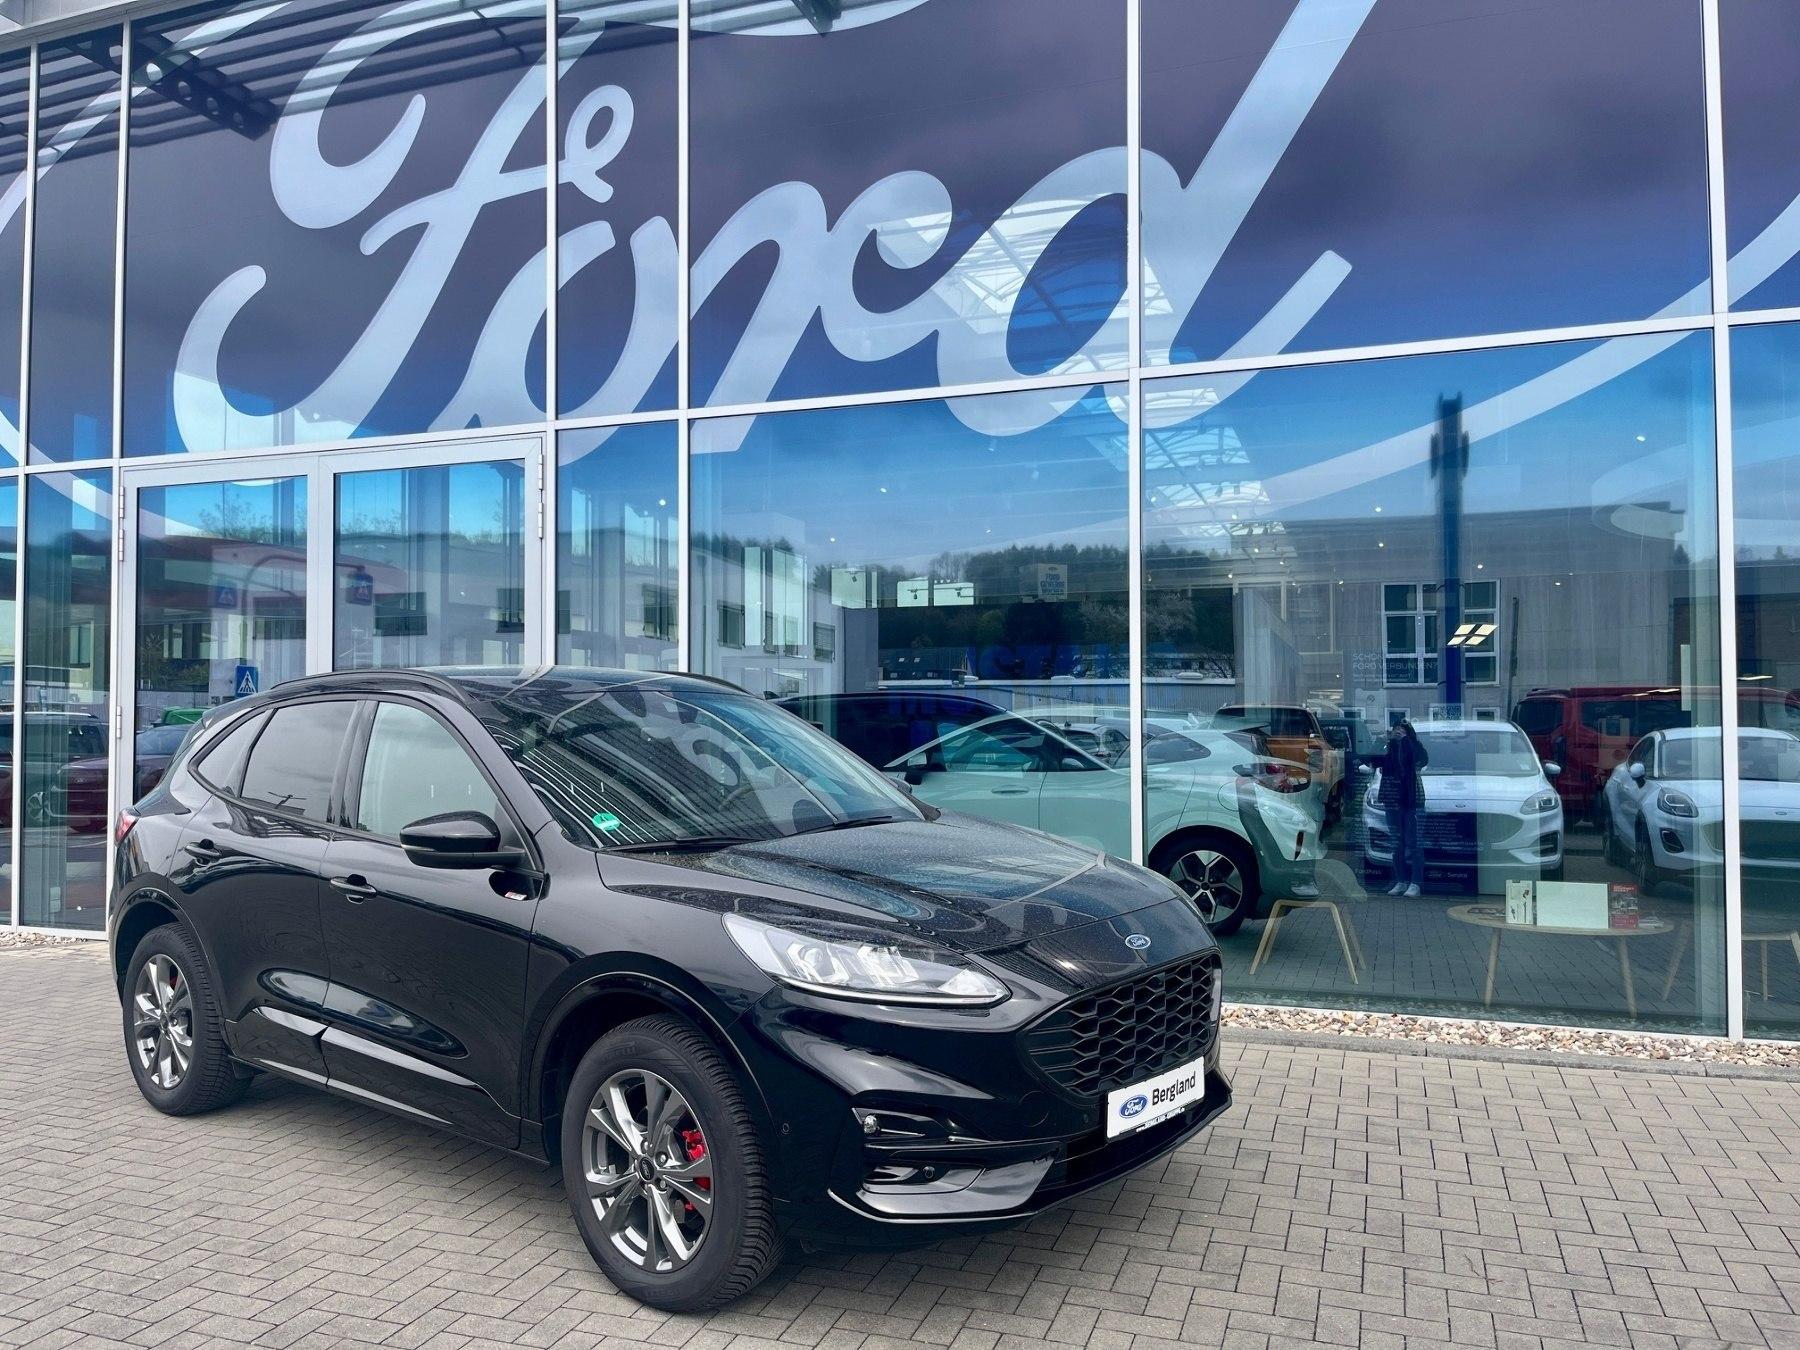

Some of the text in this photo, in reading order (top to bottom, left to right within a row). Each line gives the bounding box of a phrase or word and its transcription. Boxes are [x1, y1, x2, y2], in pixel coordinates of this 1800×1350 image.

[175, 0, 1378, 486] Ford
[1352, 662, 1377, 670] FORD
[1124, 1071, 1196, 1116] Ford Bergland
